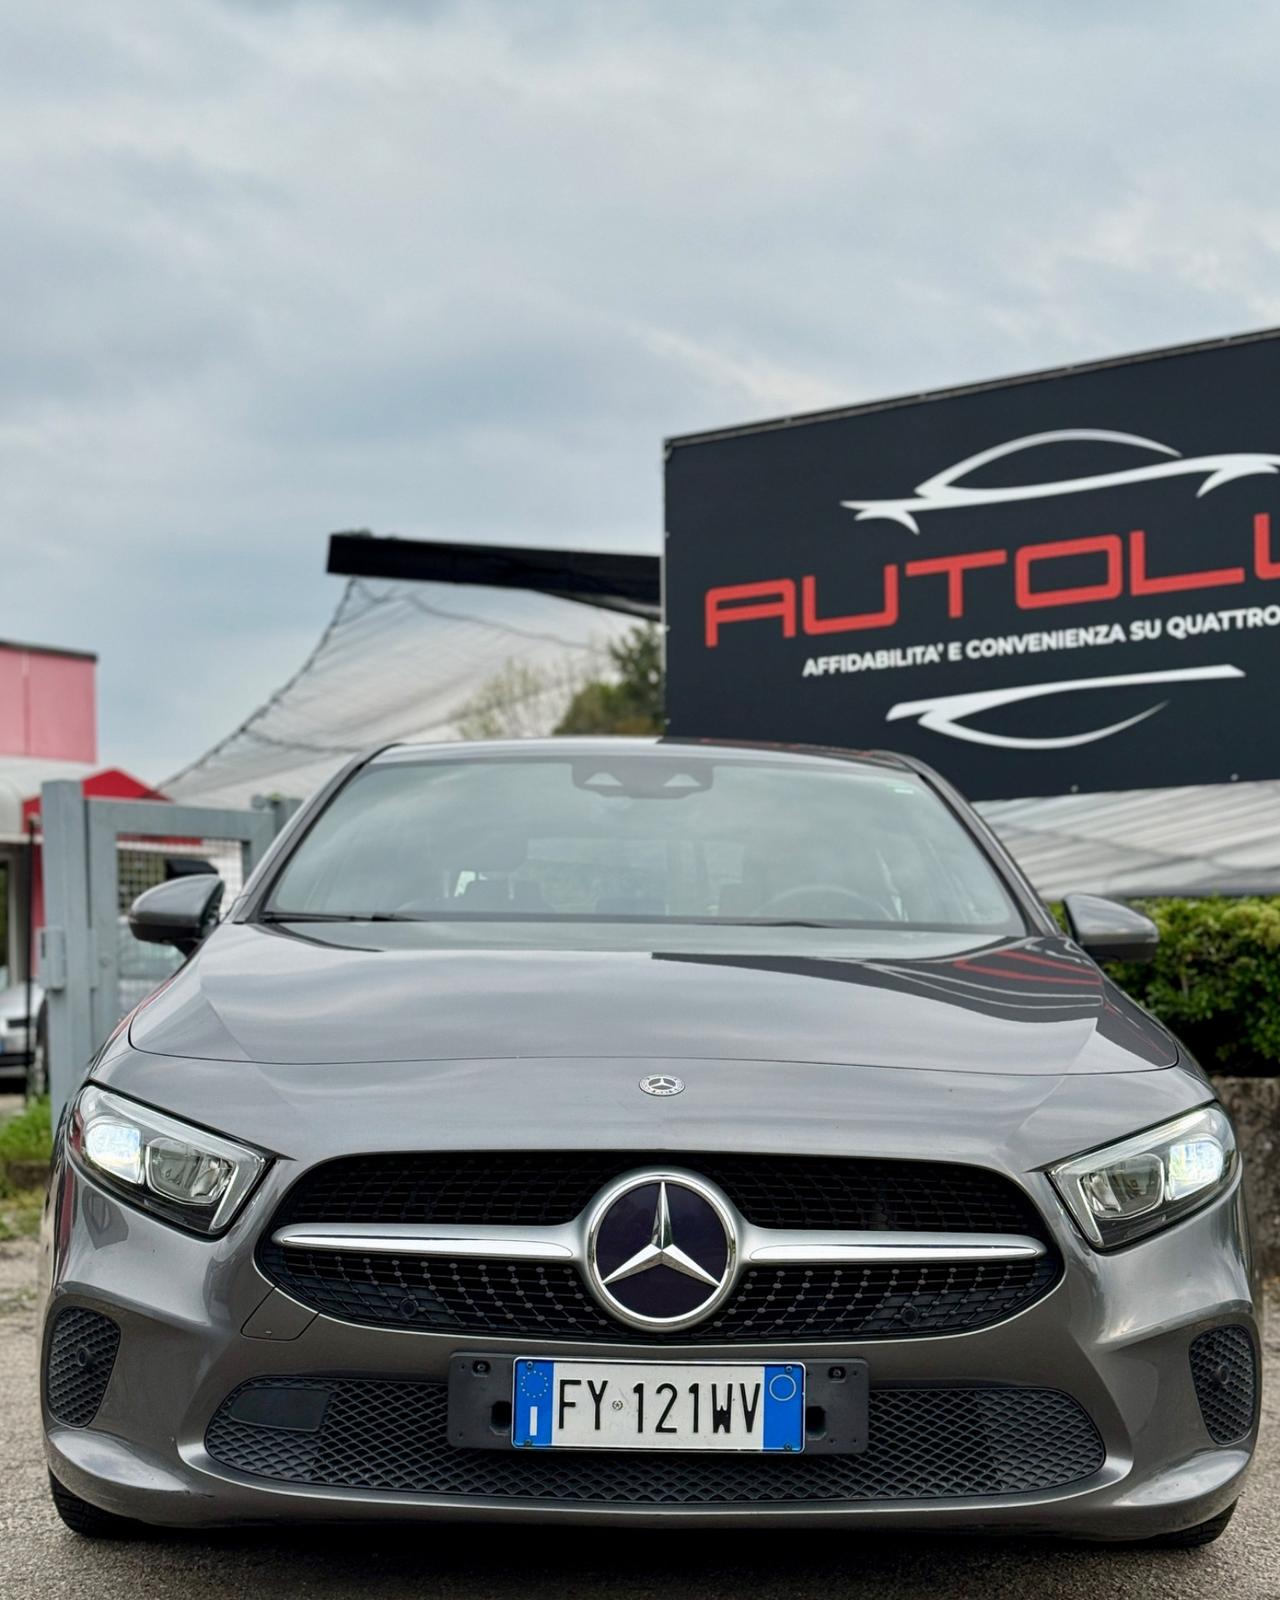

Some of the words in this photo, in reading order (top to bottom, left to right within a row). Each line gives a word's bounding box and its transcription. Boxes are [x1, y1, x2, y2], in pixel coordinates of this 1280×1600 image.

[704, 512, 1280, 648] AUTOL
[802, 642, 944, 677] AFFIDABILITA'
[947, 641, 962, 662] E
[965, 622, 1126, 658] CONVENIENZA
[1129, 618, 1162, 641] SU
[1166, 604, 1280, 640] QUATTRO
[558, 1378, 609, 1431] FY
[632, 1382, 761, 1435] 121WV
